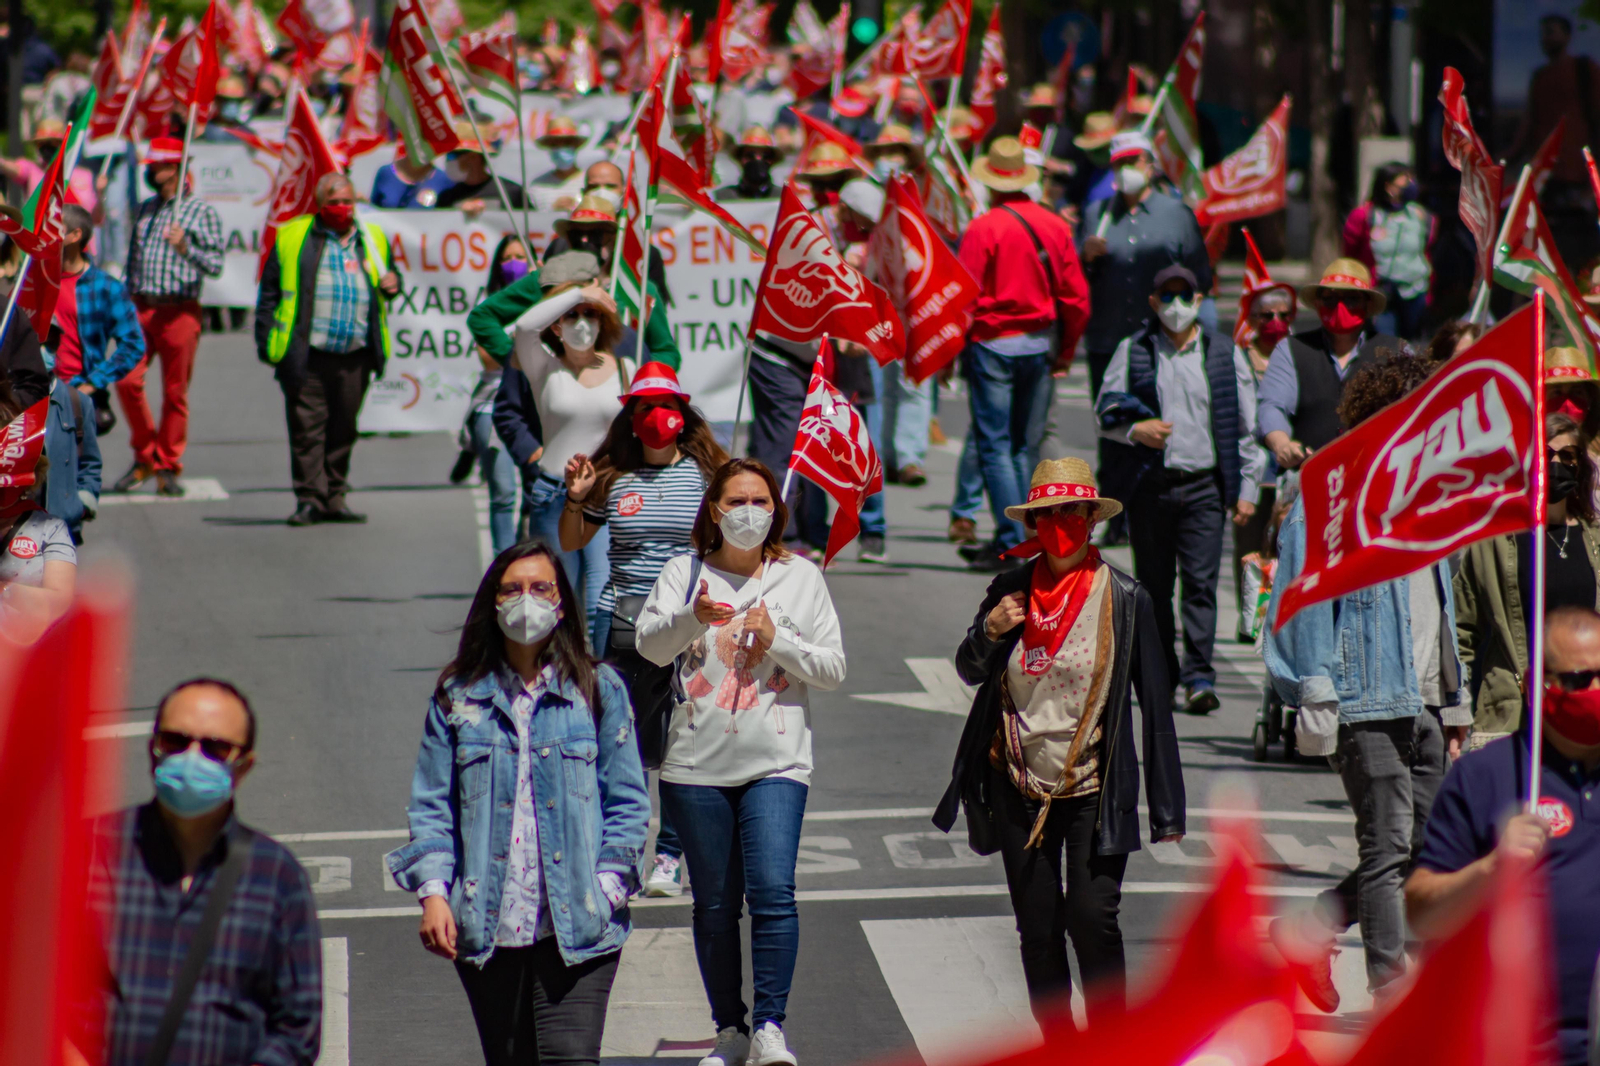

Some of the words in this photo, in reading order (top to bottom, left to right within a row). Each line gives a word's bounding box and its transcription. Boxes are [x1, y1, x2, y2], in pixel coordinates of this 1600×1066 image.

[421, 231, 488, 272] LOS
[690, 225, 735, 264] EN
[11, 539, 36, 552] UGT
[1024, 645, 1047, 665] UGT
